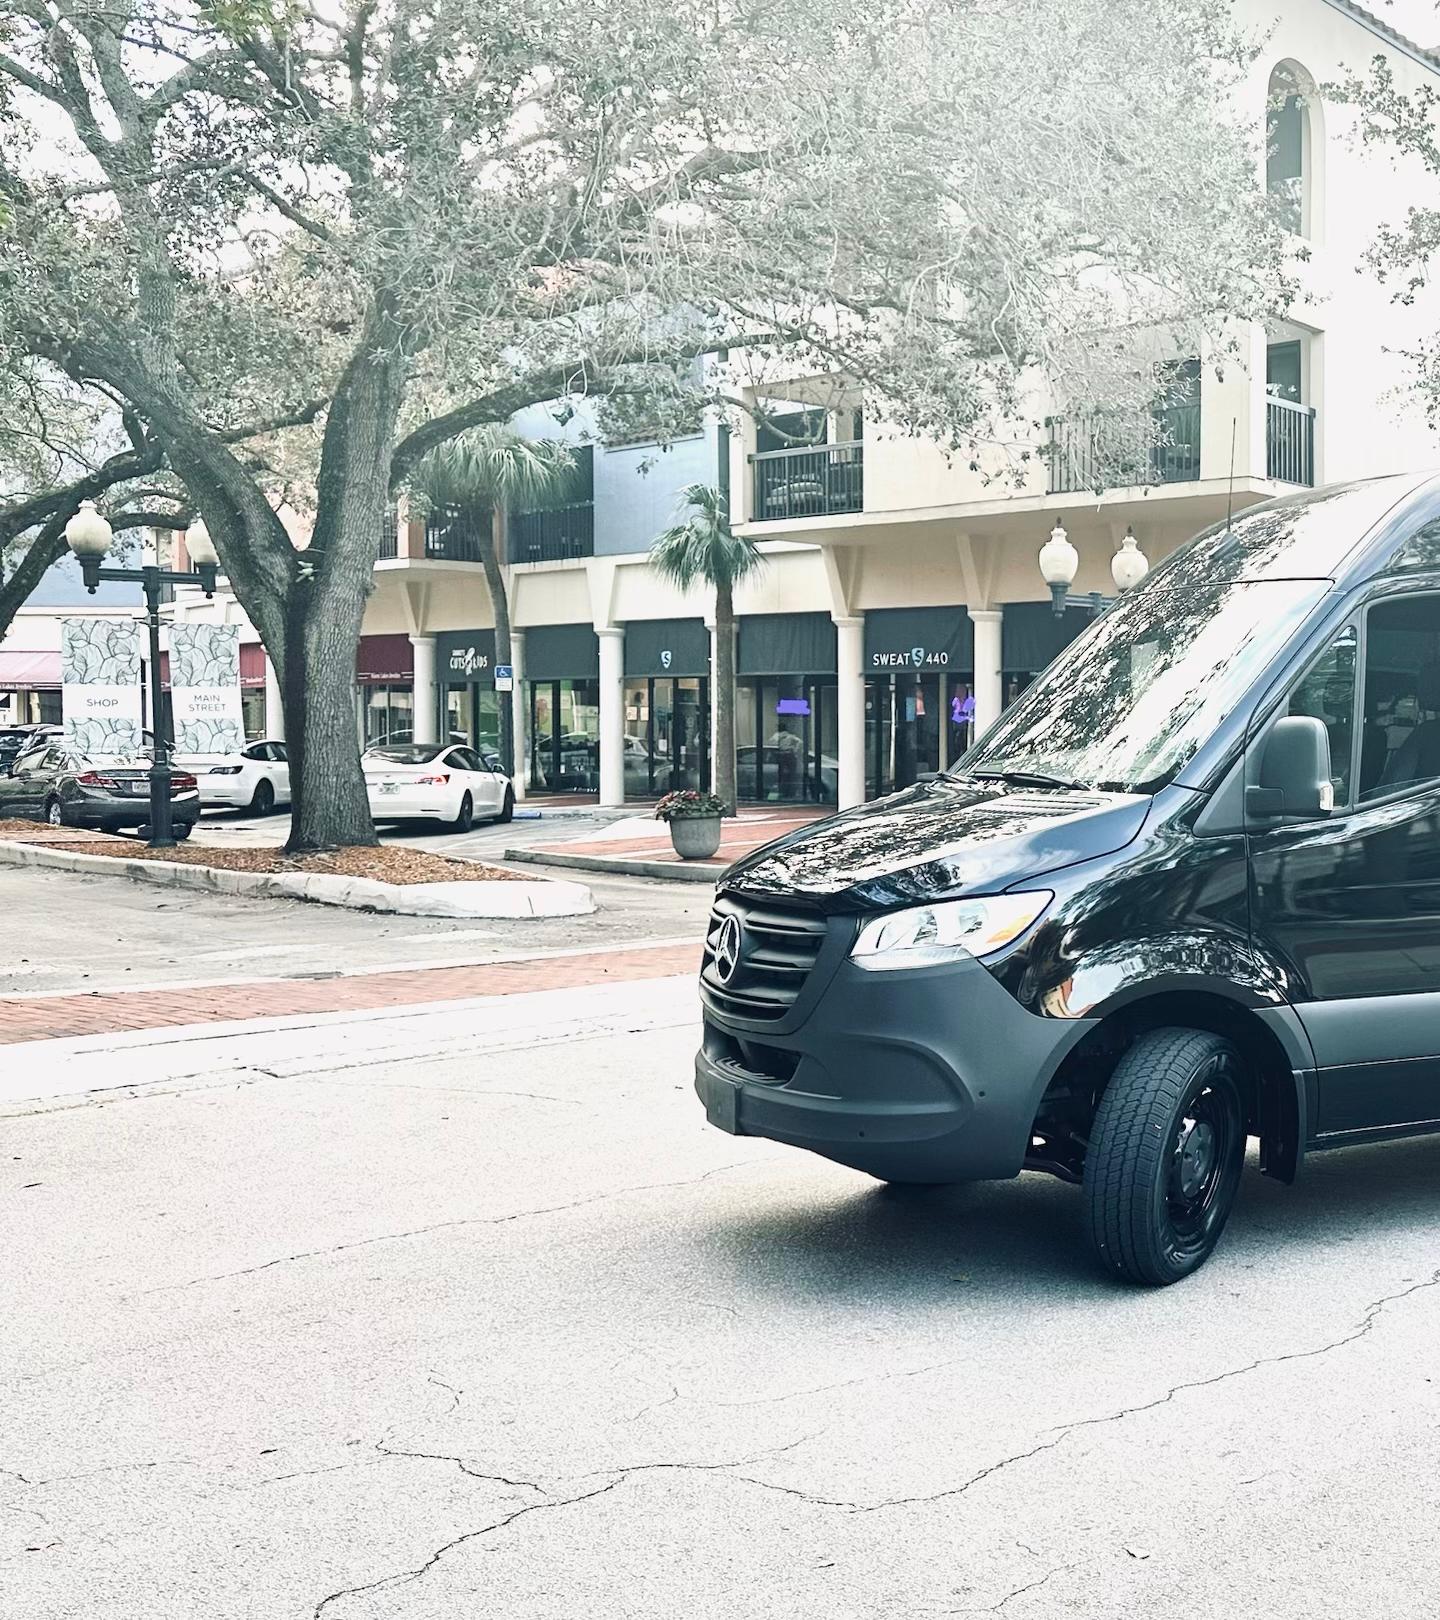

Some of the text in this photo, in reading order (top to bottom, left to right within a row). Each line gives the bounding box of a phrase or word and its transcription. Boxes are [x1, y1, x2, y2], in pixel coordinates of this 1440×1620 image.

[873, 653, 911, 666] SWEAT
[926, 652, 948, 665] 440
[87, 698, 119, 707] SHOP
[188, 703, 226, 712] STREET
